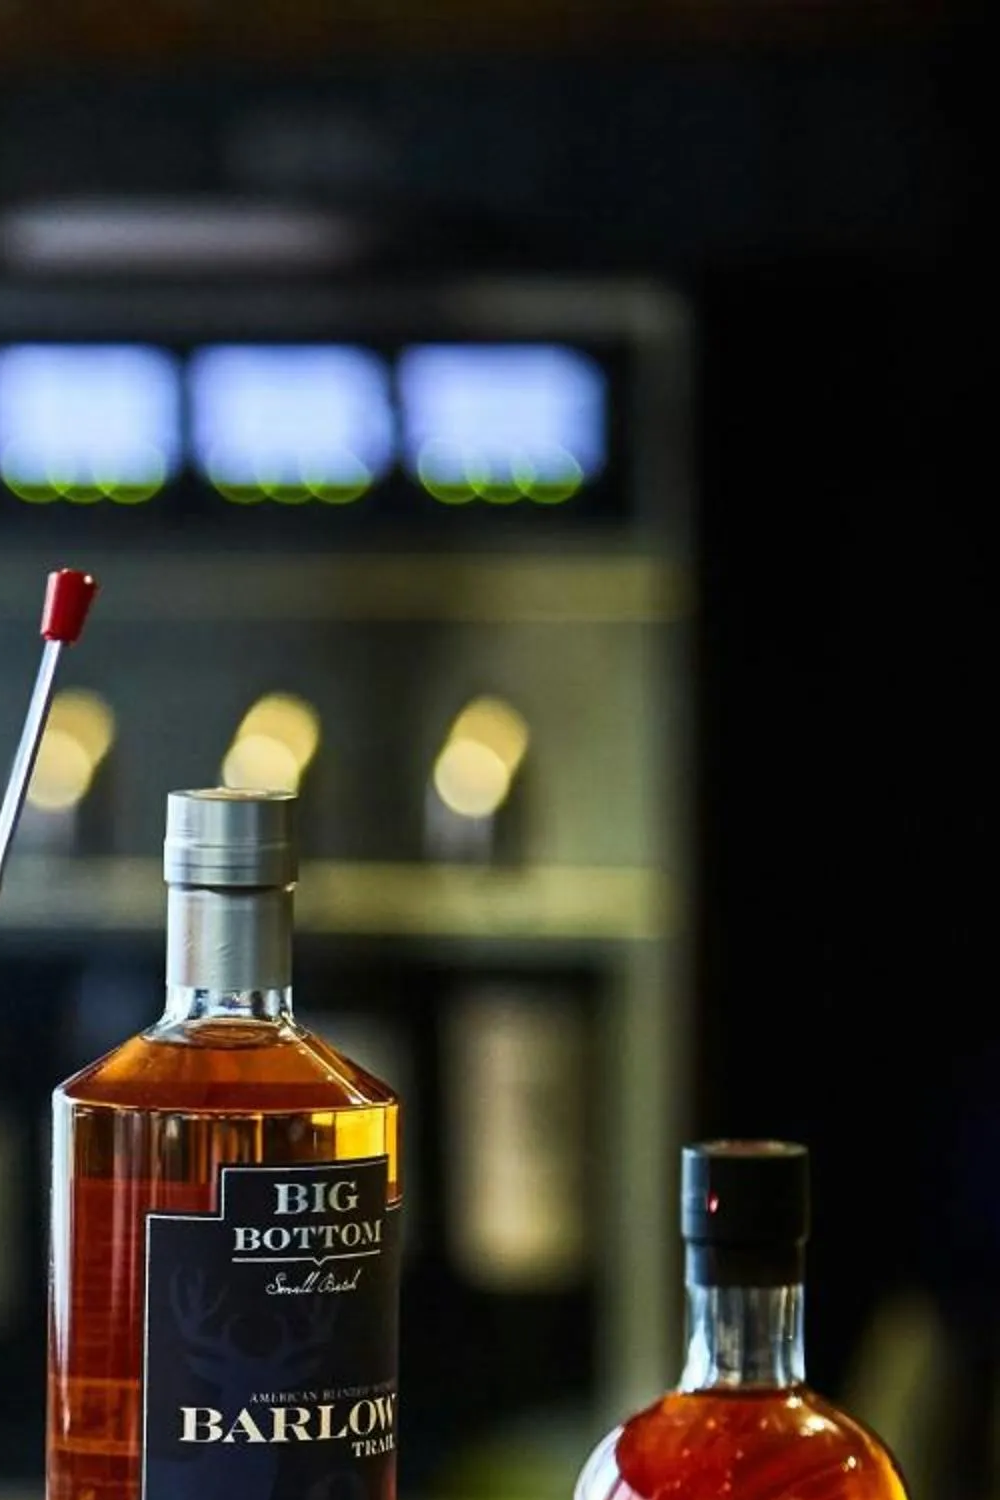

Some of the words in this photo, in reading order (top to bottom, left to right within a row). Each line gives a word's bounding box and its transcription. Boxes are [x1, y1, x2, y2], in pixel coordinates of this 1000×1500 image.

[273, 1180, 359, 1215] BIG
[232, 1219, 382, 1251] BOTTOM
[265, 1271, 321, 1295] Small
[317, 1268, 361, 1293] Batch
[178, 1393, 396, 1443] BARLOW
